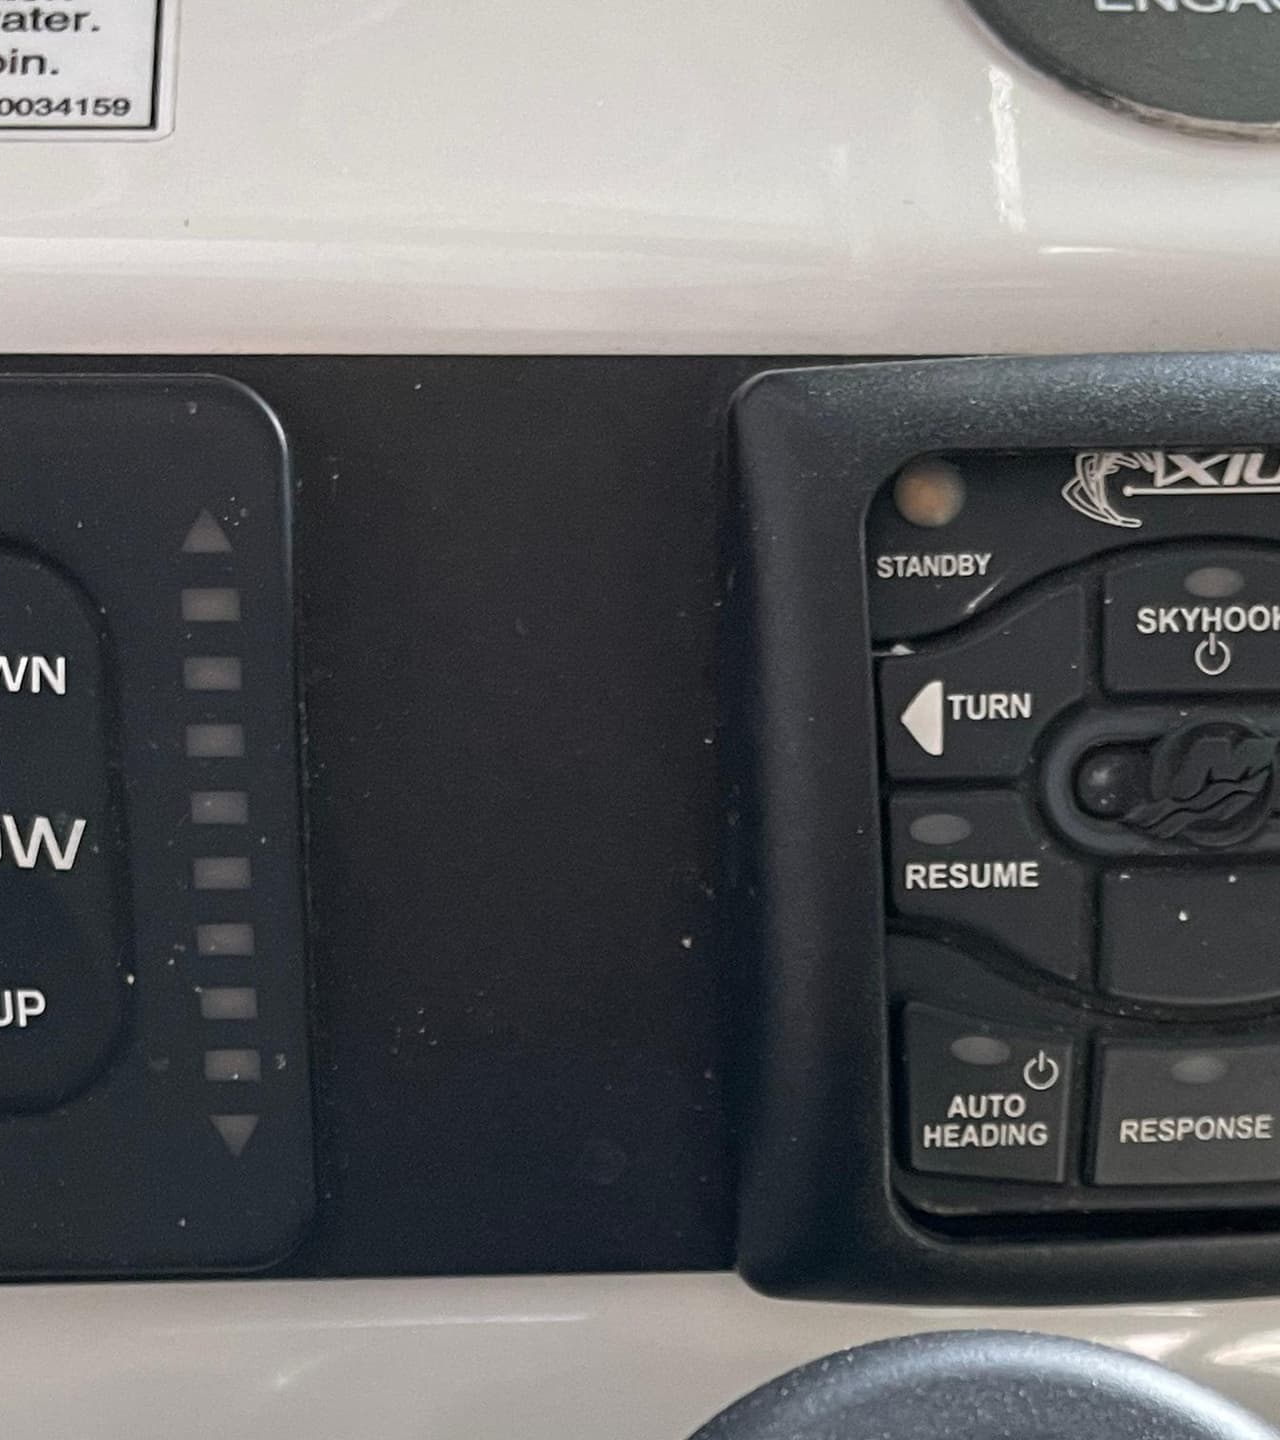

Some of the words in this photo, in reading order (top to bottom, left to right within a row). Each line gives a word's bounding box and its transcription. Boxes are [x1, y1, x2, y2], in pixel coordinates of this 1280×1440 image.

[877, 553, 992, 579] STANDBY
[949, 693, 1032, 721] TURN
[905, 862, 1040, 891] RESUME
[947, 1094, 1026, 1120] AUTO
[923, 1122, 1049, 1149] HEADING
[1120, 1115, 1274, 1145] RESPONSE
